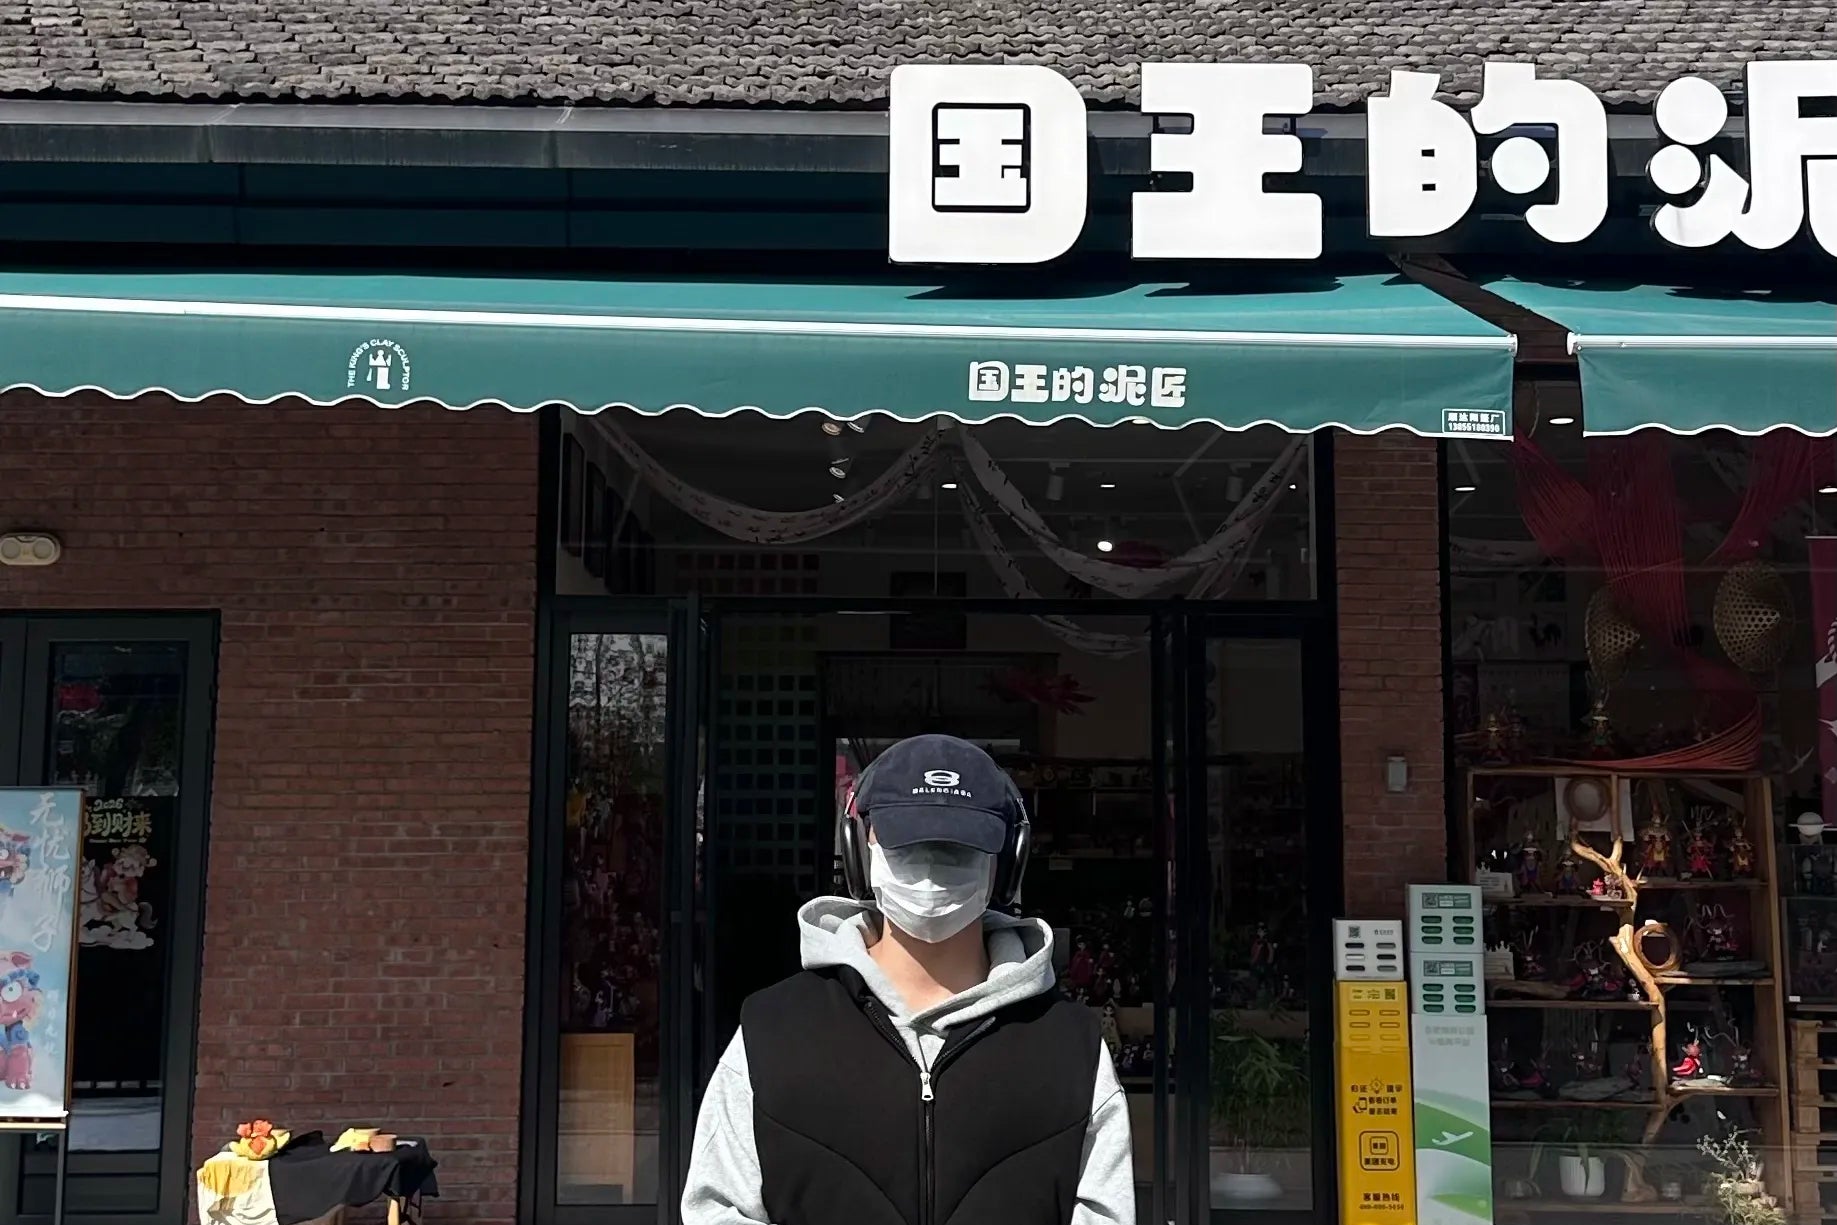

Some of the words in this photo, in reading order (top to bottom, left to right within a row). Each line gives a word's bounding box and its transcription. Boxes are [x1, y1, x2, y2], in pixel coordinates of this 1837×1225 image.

[349, 342, 370, 369] KING'S
[369, 339, 395, 347] CLAY
[347, 370, 356, 388] THE
[393, 344, 411, 391] SCULPTOR
[968, 360, 1187, 408] 国王的泥匠
[93, 797, 125, 812] 2026
[30, 791, 70, 953] 无忧狮子
